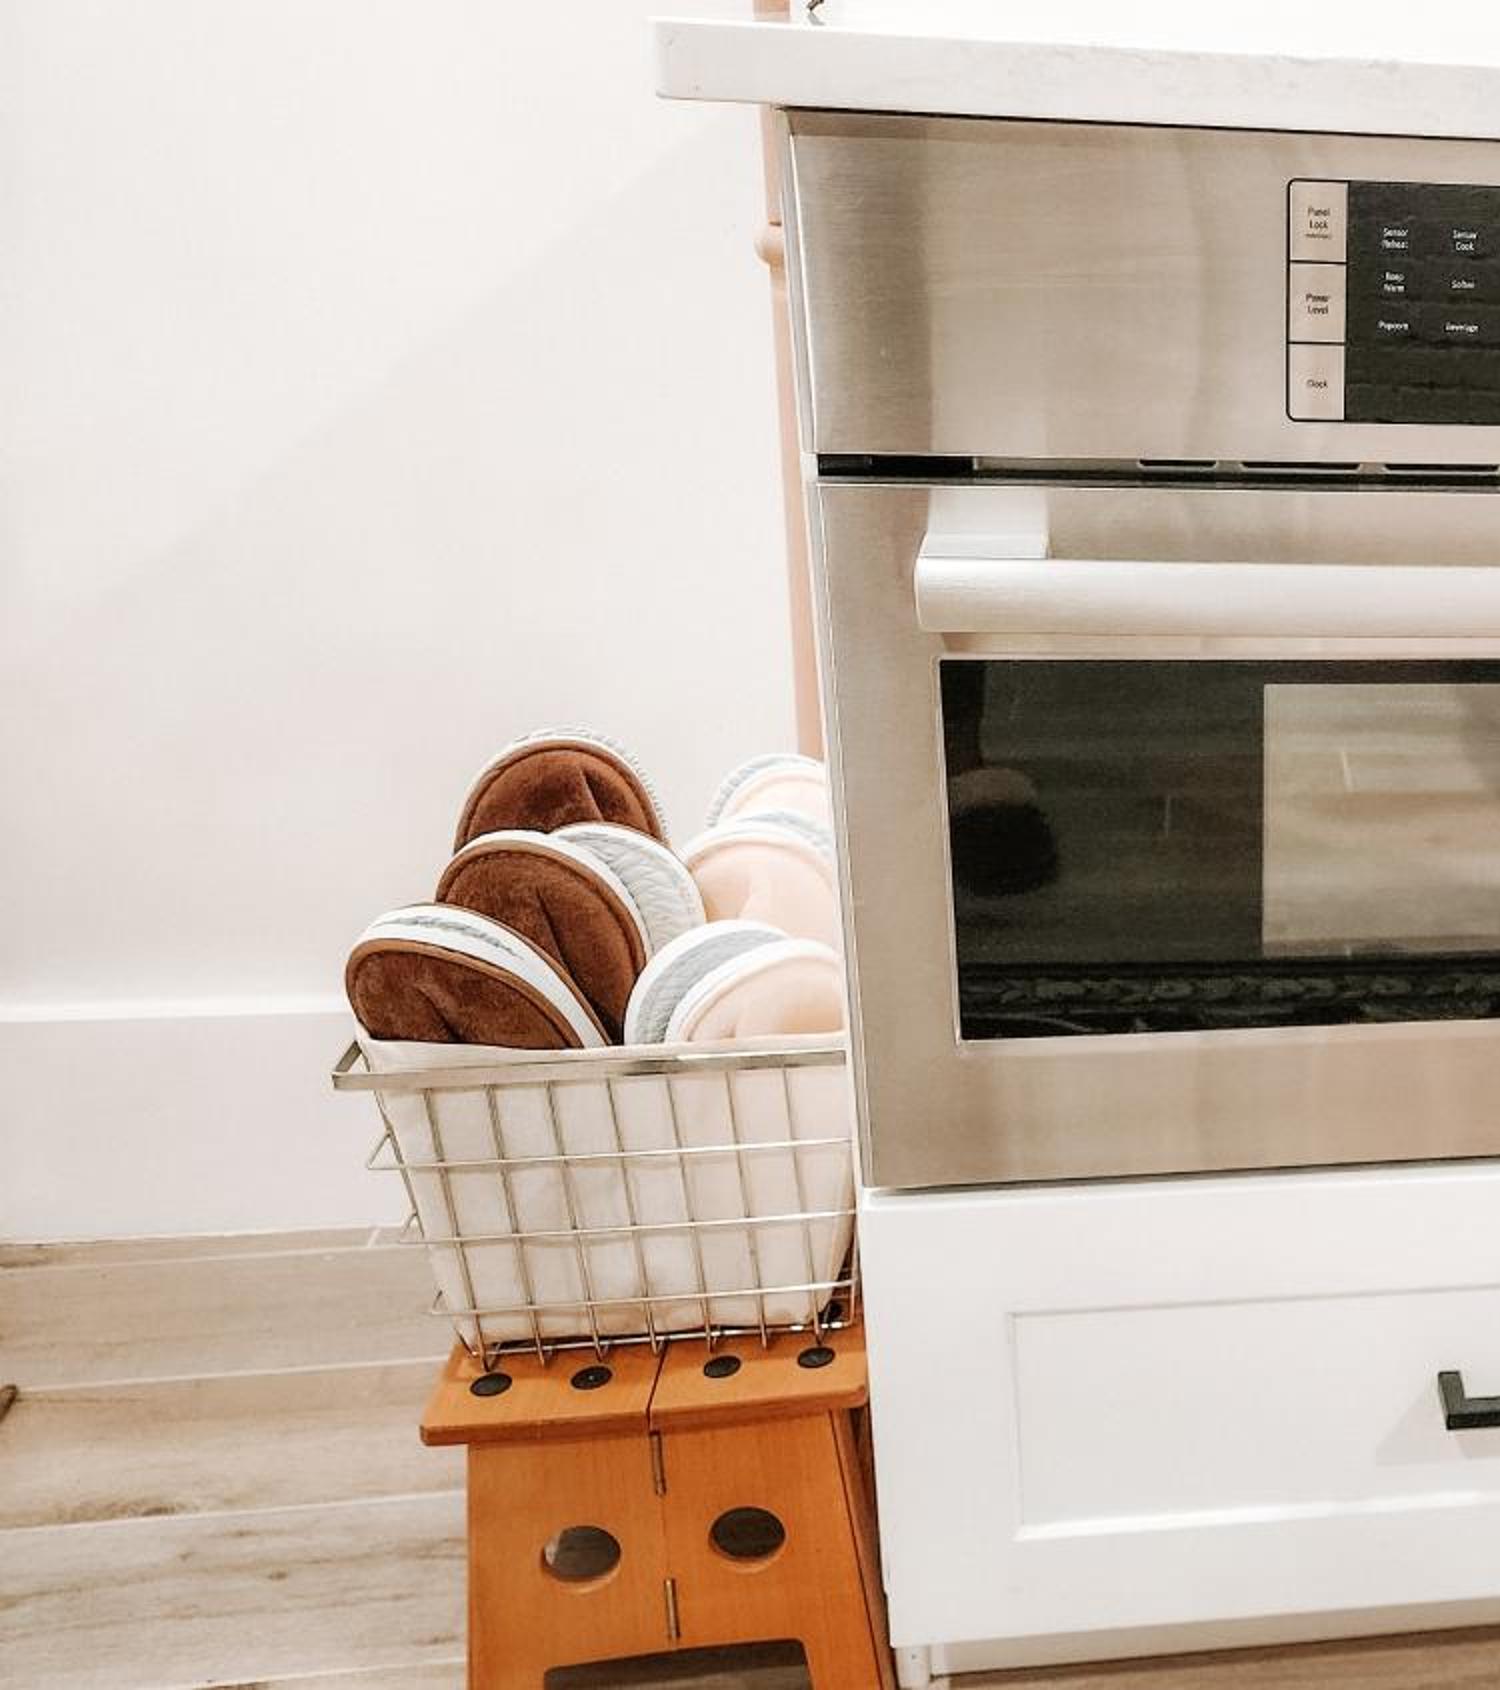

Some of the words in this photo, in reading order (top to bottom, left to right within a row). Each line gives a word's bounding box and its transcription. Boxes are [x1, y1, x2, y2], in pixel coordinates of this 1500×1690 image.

[1309, 219, 1329, 229] Lock
[1383, 228, 1409, 237] Sensor
[1455, 241, 1475, 251] Cook
[1307, 305, 1329, 315] Level
[1306, 379, 1329, 389] Clock
